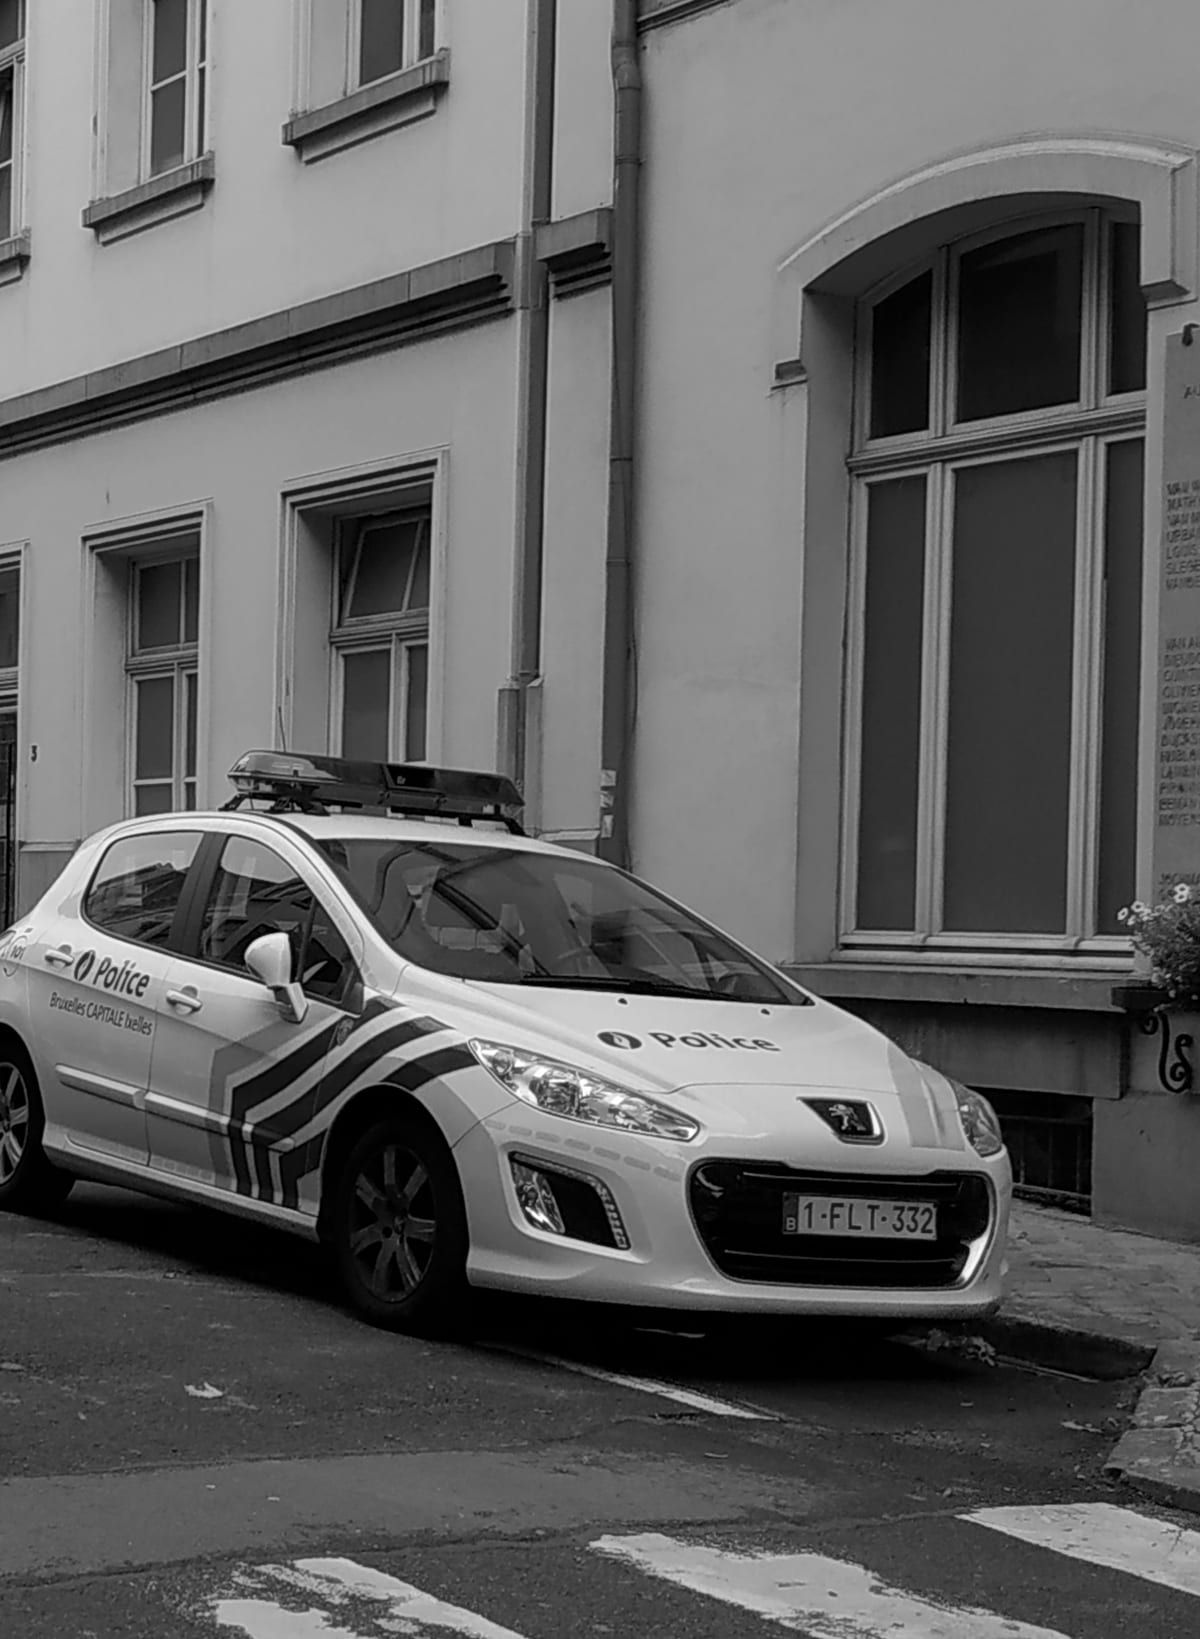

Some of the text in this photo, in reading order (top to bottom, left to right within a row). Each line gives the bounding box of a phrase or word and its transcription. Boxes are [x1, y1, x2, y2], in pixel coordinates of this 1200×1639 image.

[31, 745, 38, 762] 3
[93, 956, 150, 998] Police
[49, 992, 152, 1036] Bruxelles CAPITALE Ixelles
[648, 1030, 780, 1052] Police
[786, 1199, 934, 1235] B 1-FLT-332
